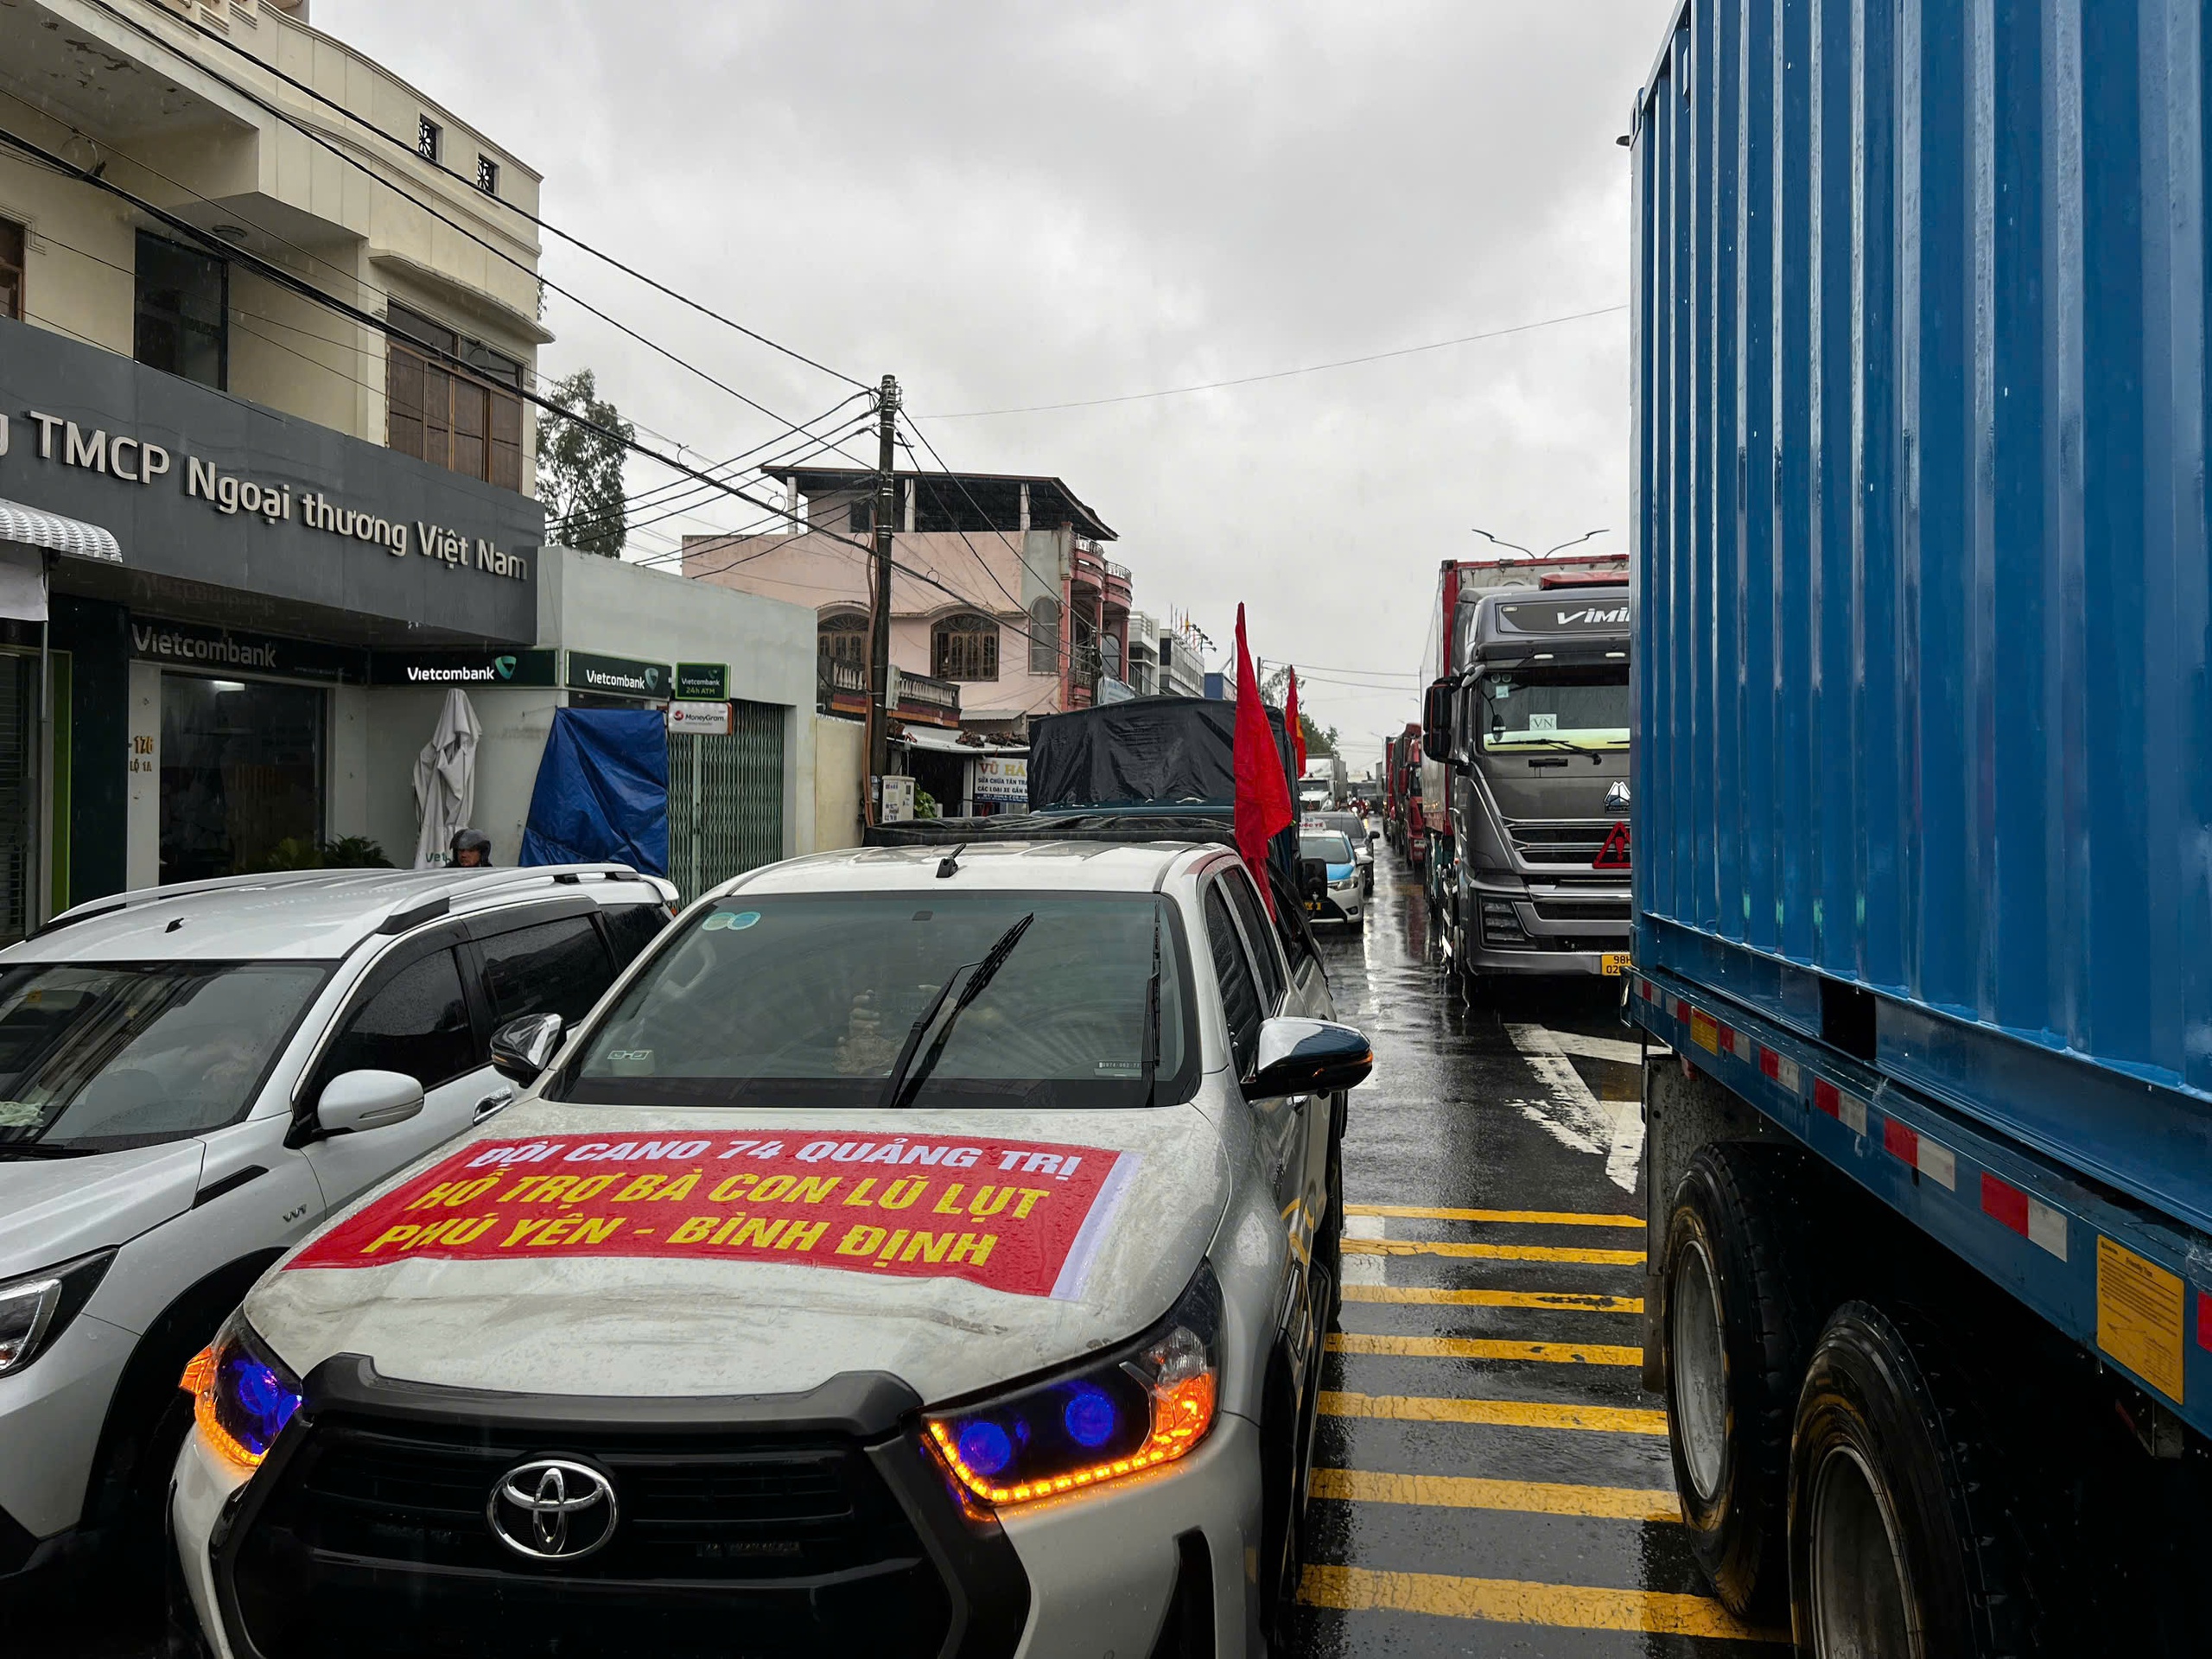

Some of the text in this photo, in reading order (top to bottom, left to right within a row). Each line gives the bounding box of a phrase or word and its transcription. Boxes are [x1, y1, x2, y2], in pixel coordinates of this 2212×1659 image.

[29, 410, 170, 484] TMCP
[188, 455, 290, 524] Ngoại
[302, 493, 407, 556] thương
[416, 521, 468, 569] Việt
[477, 538, 528, 580] Nam
[131, 623, 276, 668] Vietcombank
[407, 666, 494, 681] Vietcombank
[586, 669, 645, 690] Vietcombank
[681, 677, 721, 686] Vietcombank
[685, 714, 724, 722] MoneyGram
[1534, 718, 1553, 728] VN
[1606, 965, 1621, 974] 02
[464, 1137, 1083, 1181] ĐỘI CANO 74 QUẢNG TRỊ
[404, 1168, 1050, 1223] HỖ TRỢ BÀ CON LŨ LỤT
[359, 1212, 501, 1254] PHÚ
[499, 1212, 628, 1248] YÊN
[664, 1211, 830, 1251] BÌNH
[835, 1225, 999, 1268] ĐỊNH
